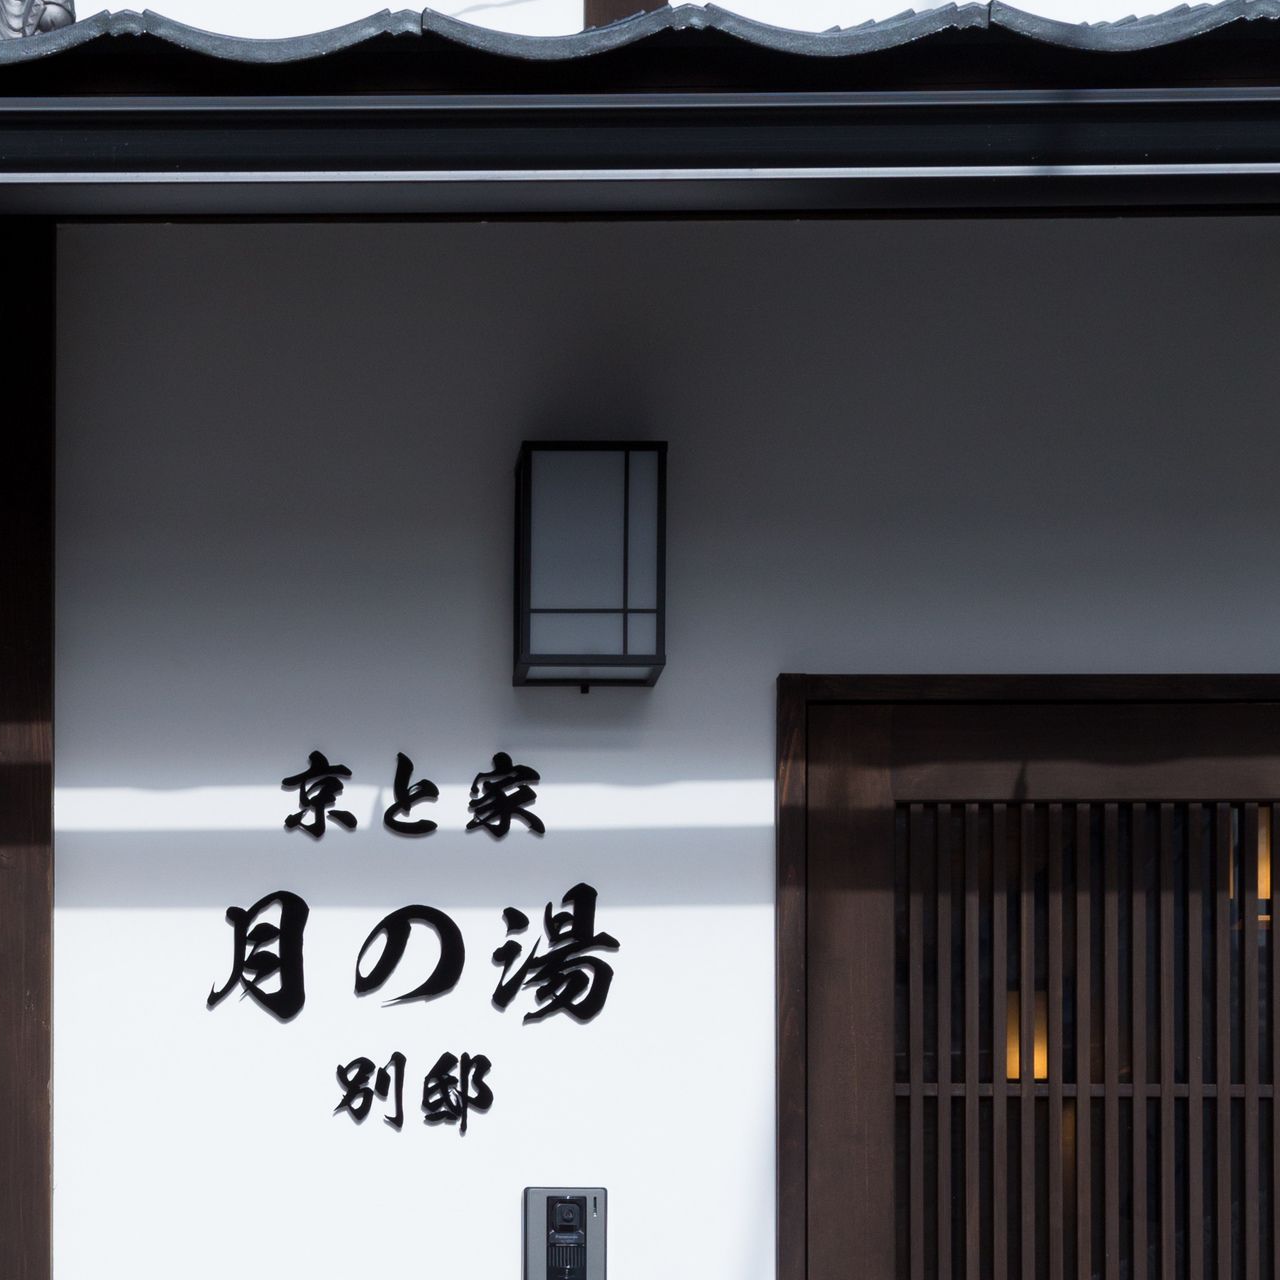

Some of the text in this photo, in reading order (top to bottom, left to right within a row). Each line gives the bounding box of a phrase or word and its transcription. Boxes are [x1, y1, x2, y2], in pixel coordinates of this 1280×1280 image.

[281, 750, 546, 839] 京と家
[207, 882, 620, 1024] 月の湯
[333, 1051, 494, 1134] 別邸
